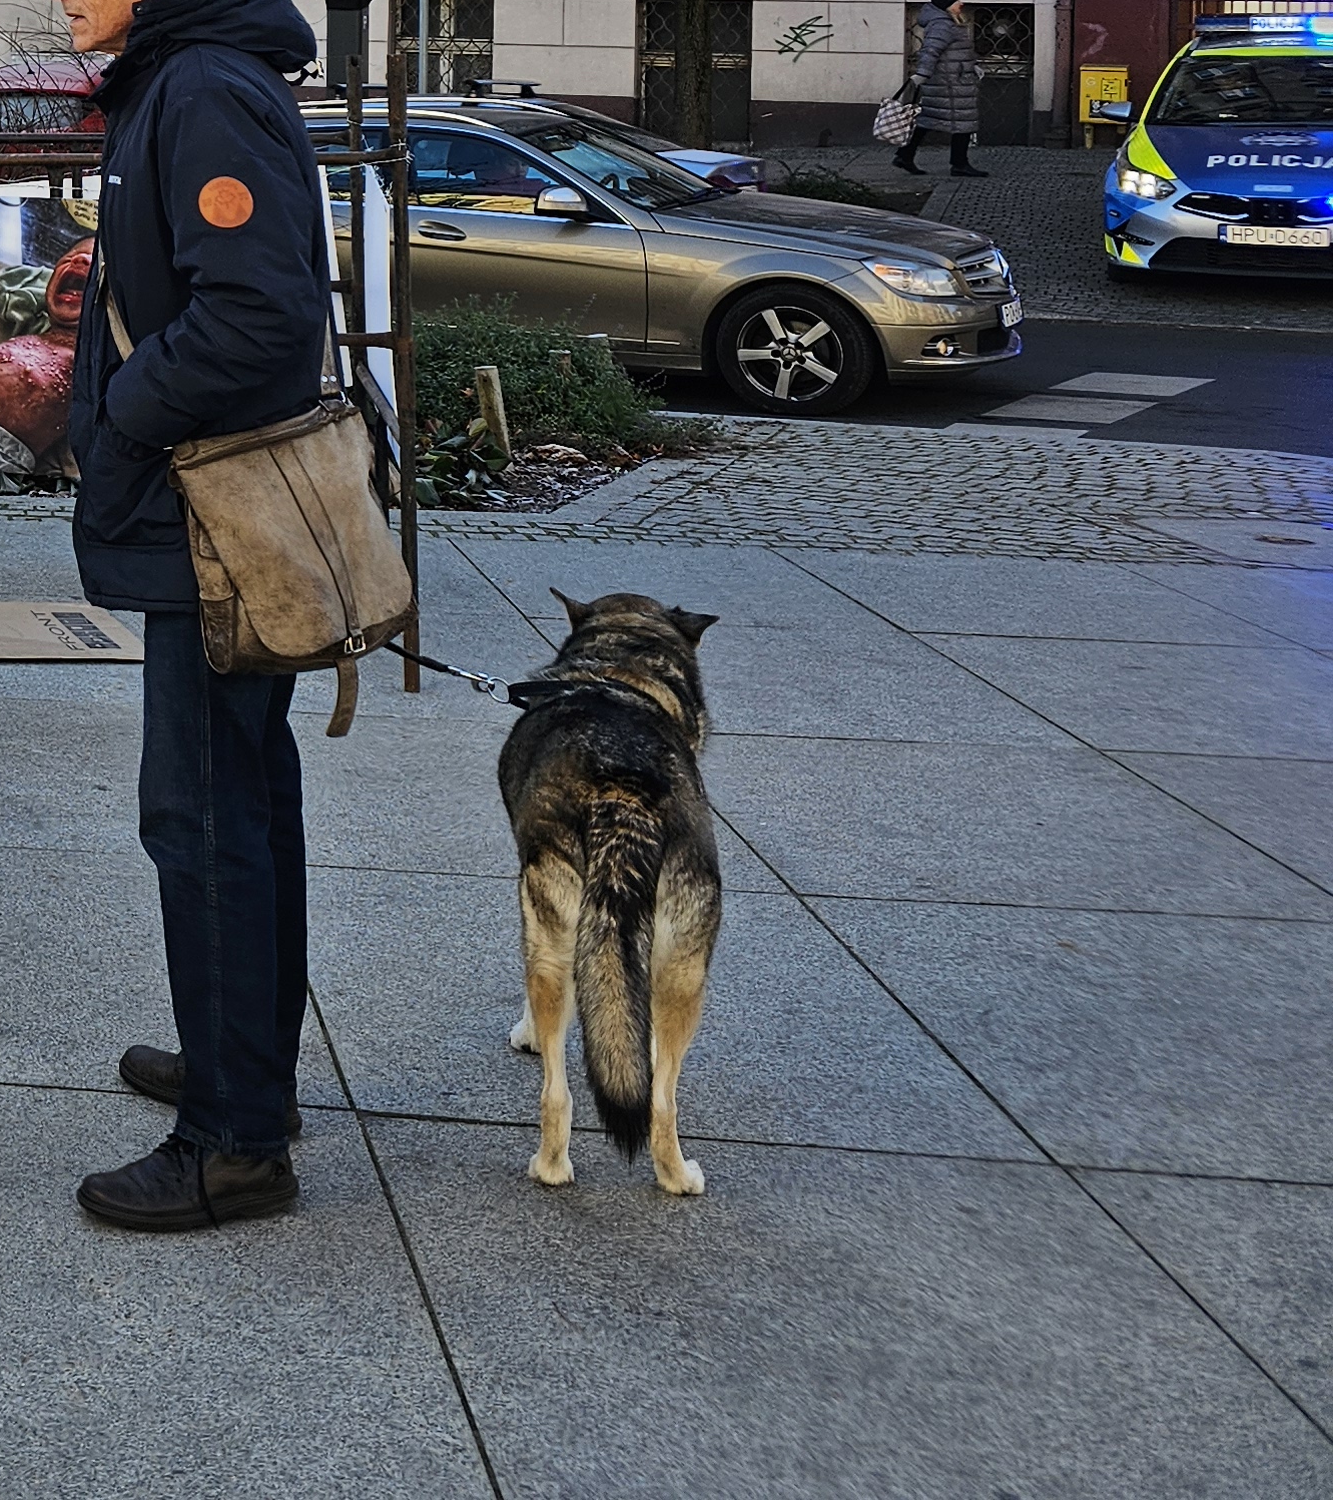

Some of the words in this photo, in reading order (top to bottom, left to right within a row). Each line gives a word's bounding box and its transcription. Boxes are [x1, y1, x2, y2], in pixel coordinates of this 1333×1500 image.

[1232, 228, 1267, 243] HPU
[1275, 229, 1322, 245] D660
[30, 609, 86, 651] FRONT
